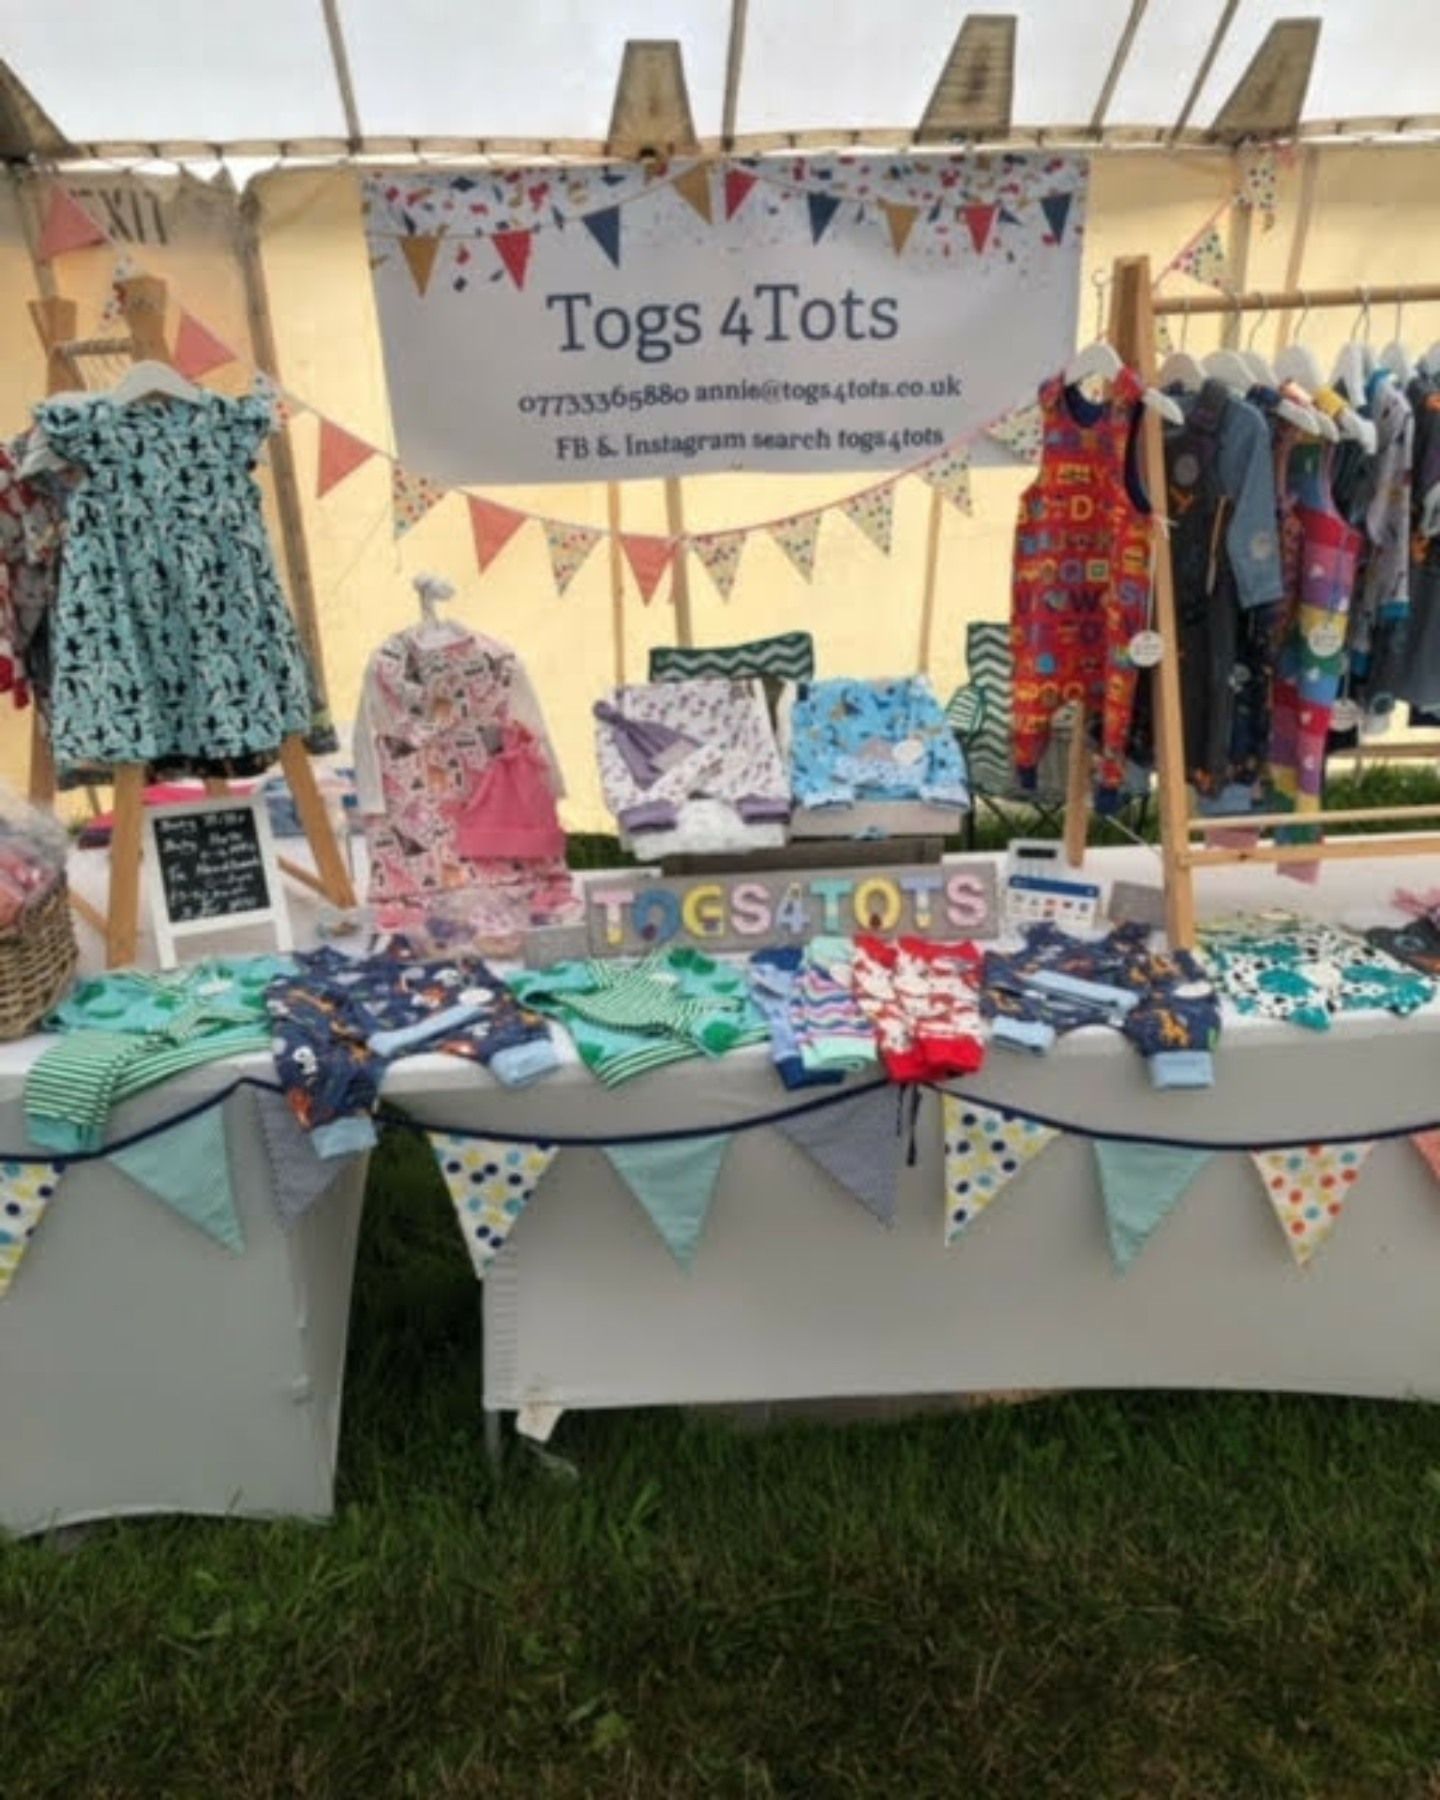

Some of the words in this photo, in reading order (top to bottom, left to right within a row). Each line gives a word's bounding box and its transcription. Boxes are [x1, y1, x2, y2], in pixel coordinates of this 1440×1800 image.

[68, 187, 168, 245] XIT
[546, 292, 702, 364] Togs
[720, 283, 899, 347] 4Tots
[517, 383, 690, 417] 07733365880
[694, 374, 962, 406] annie@togs4tots.co.uk
[557, 436, 589, 460] FB
[596, 433, 619, 457] &
[625, 432, 745, 459] Instagram
[753, 427, 831, 449] search
[838, 427, 944, 454] togs4tots
